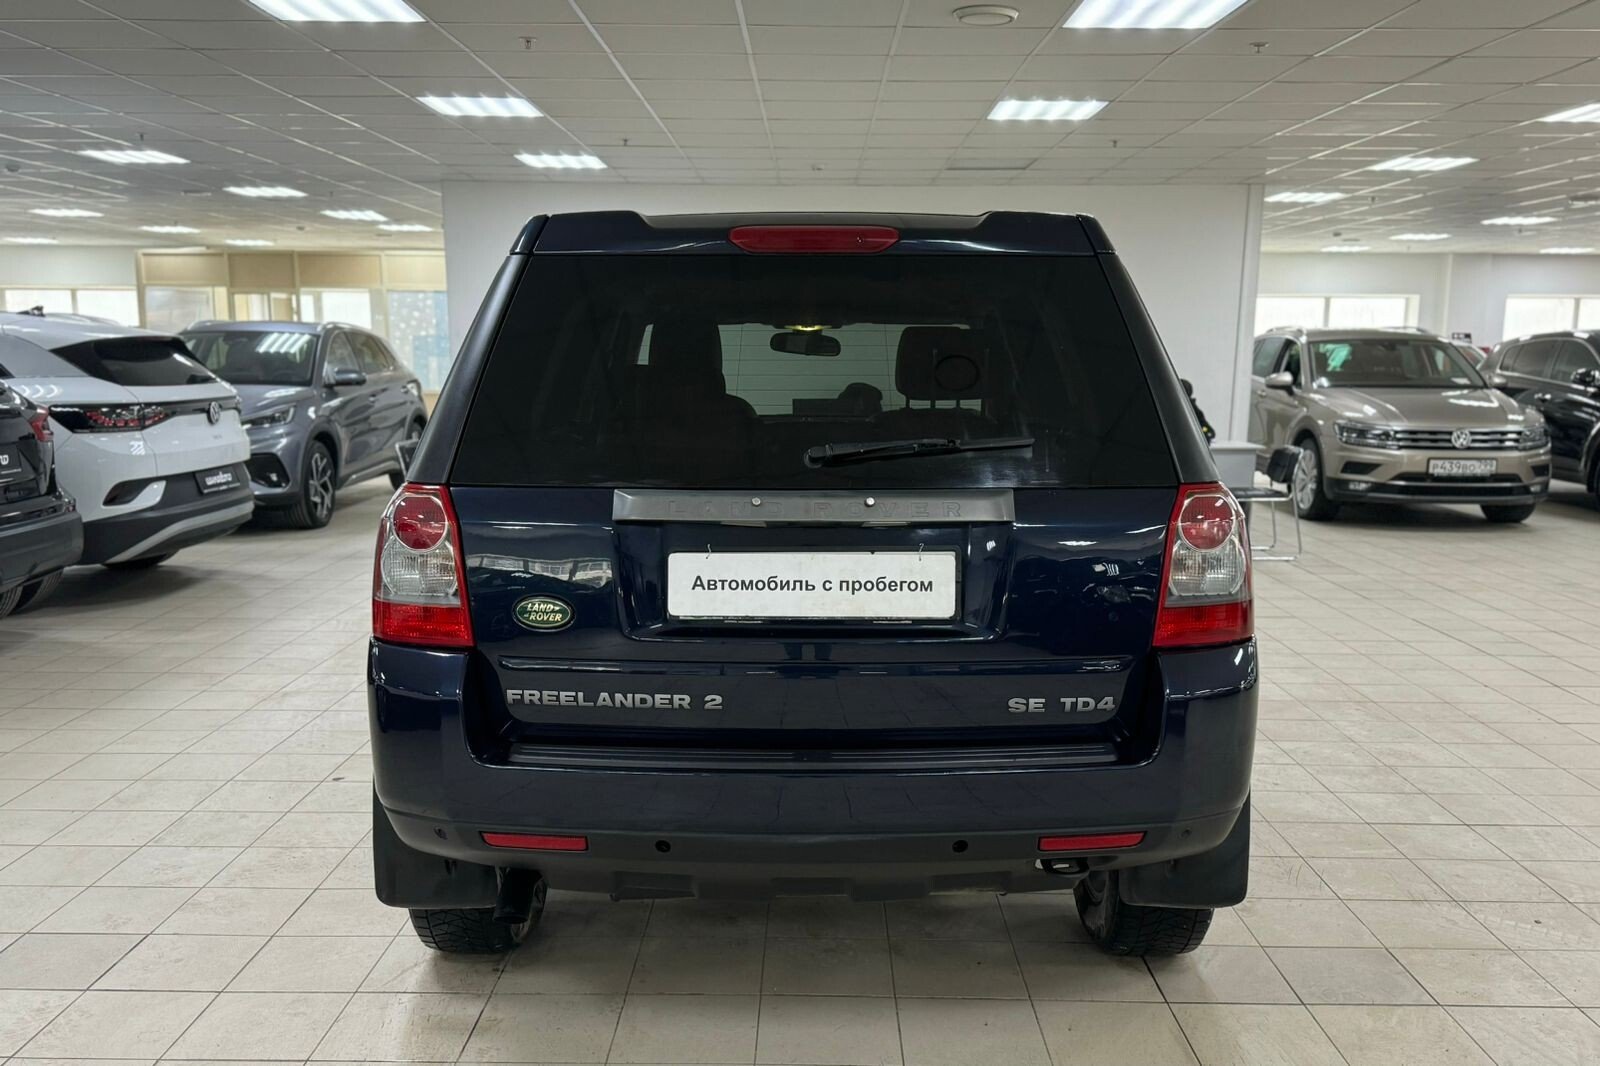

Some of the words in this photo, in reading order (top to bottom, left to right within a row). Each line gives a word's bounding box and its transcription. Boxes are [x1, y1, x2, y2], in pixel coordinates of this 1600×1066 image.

[664, 500, 783, 516] LAND
[813, 500, 963, 517] ROVER
[691, 575, 816, 592] Автомобиль
[822, 579, 833, 592] с
[839, 576, 934, 595] пробегом
[526, 602, 555, 612] LAND
[529, 612, 563, 622] ROVER
[506, 689, 691, 710] FREELANDER
[703, 694, 723, 710] 2
[1007, 697, 1046, 713] SE
[1060, 696, 1116, 713] TD4
